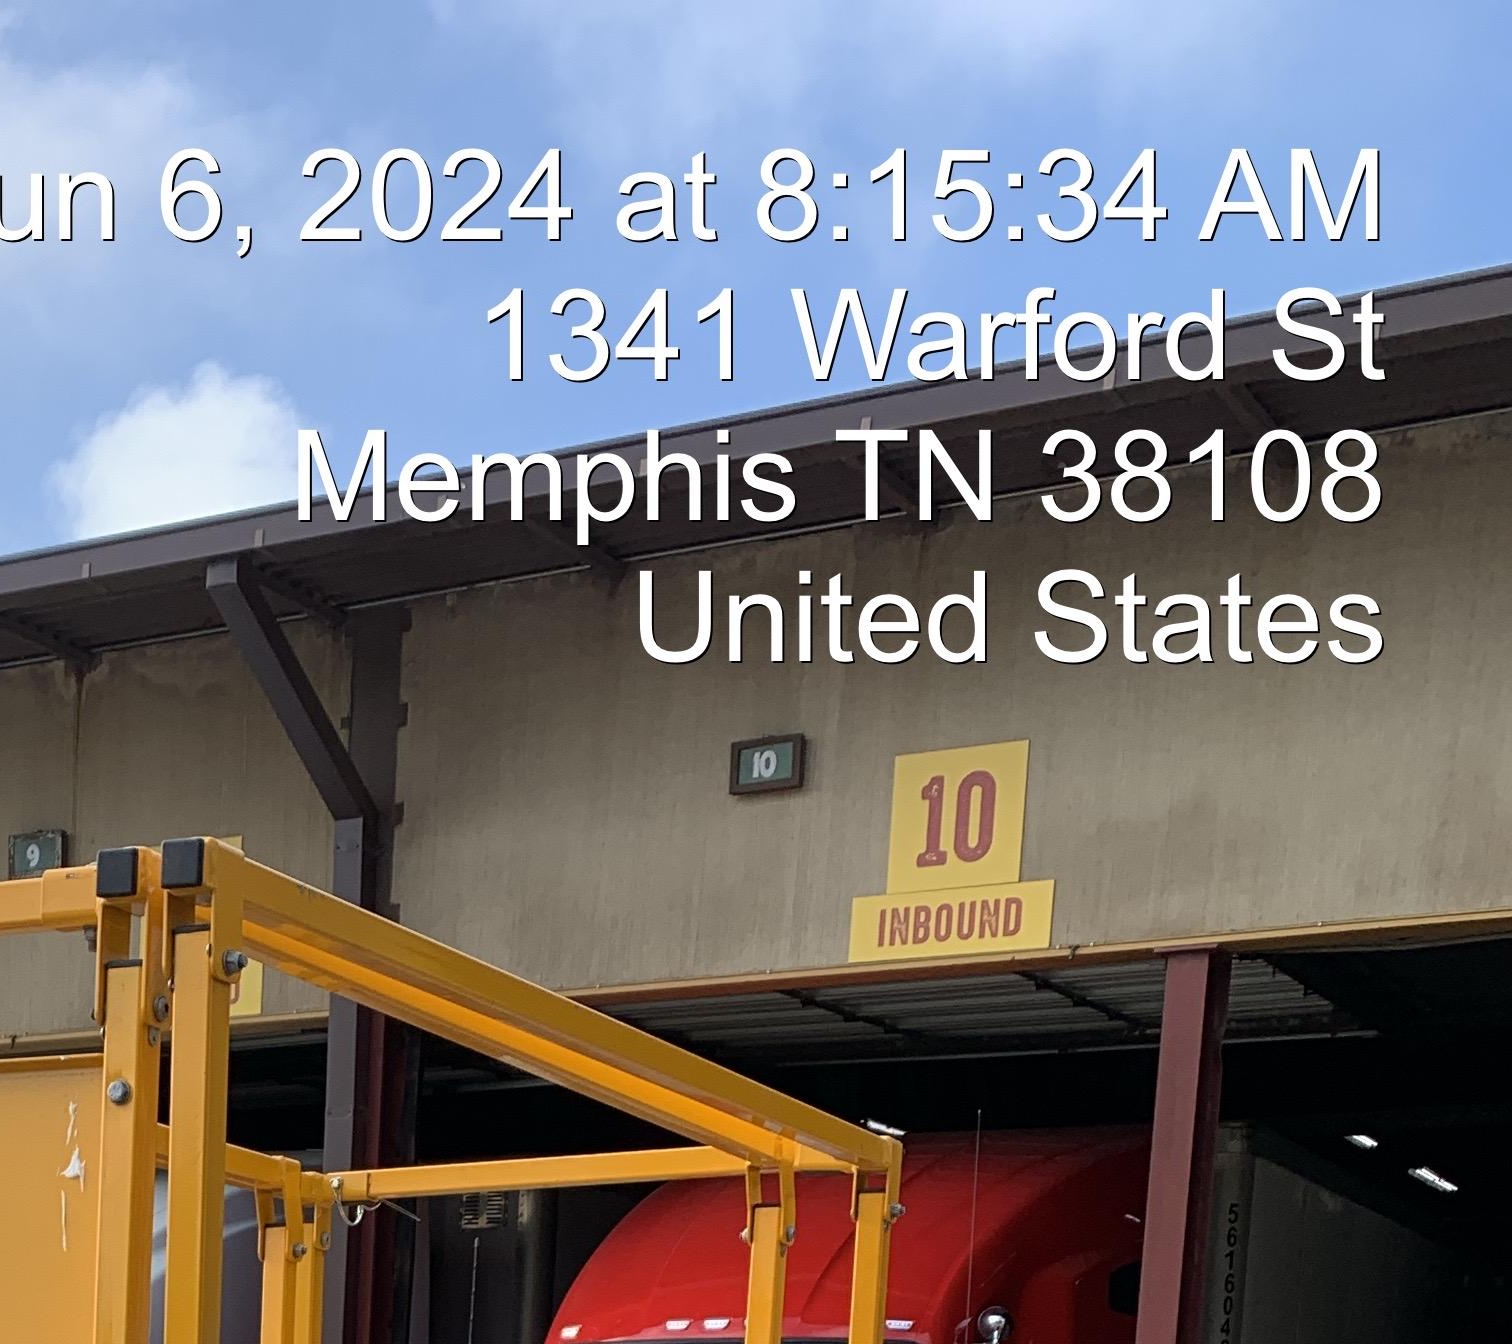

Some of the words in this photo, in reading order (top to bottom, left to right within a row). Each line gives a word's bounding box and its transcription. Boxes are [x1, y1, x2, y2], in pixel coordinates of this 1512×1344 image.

[752, 750, 777, 778] 10
[916, 770, 997, 868] 10
[26, 843, 40, 867] 9
[877, 897, 1023, 948] INBOUND
